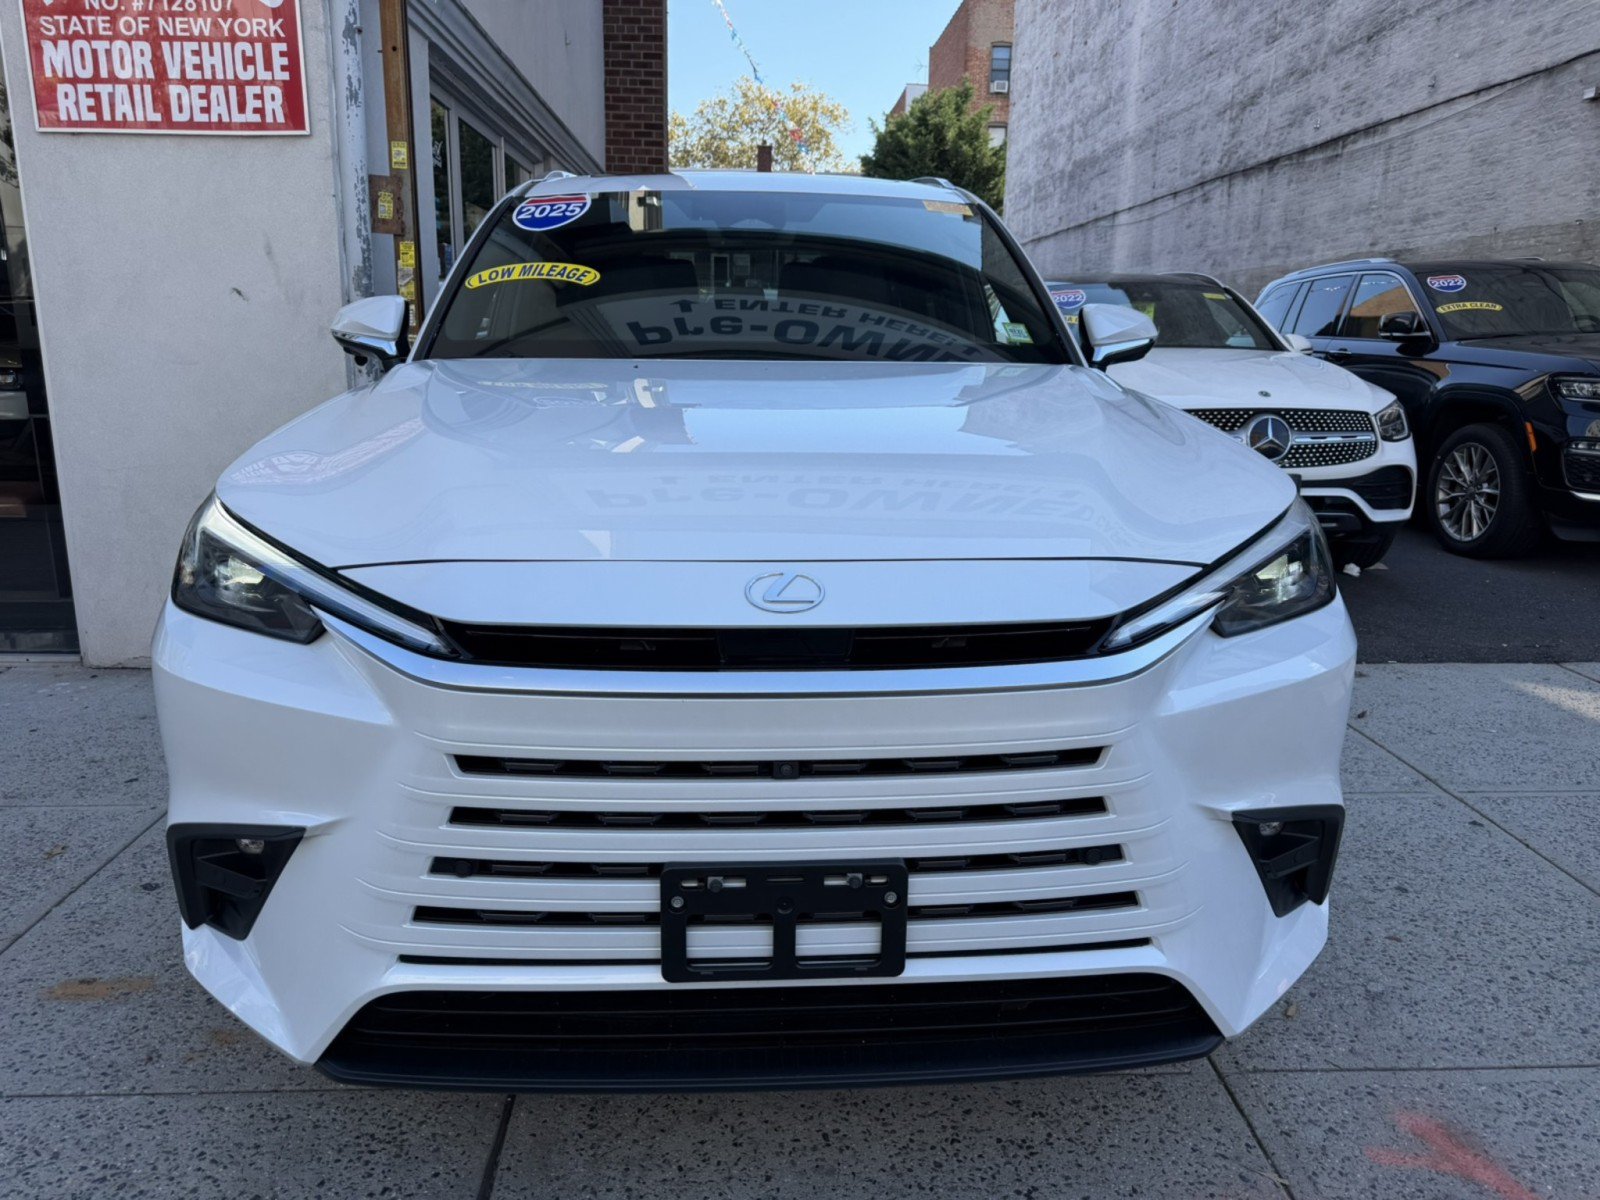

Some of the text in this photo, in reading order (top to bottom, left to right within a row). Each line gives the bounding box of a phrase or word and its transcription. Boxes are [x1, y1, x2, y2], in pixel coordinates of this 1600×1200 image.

[84, 0, 126, 11] NO.
[39, 15, 286, 38] STATE OF NEW YORK
[41, 39, 291, 82] MOTOR VEHICLE
[56, 83, 286, 124] RETAIL DEALER
[517, 202, 584, 220] 2025
[478, 263, 591, 285] LOW MILEAGE
[1432, 279, 1463, 287] 2022
[1054, 294, 1083, 303] 2022
[1441, 303, 1467, 311] EXTRA
